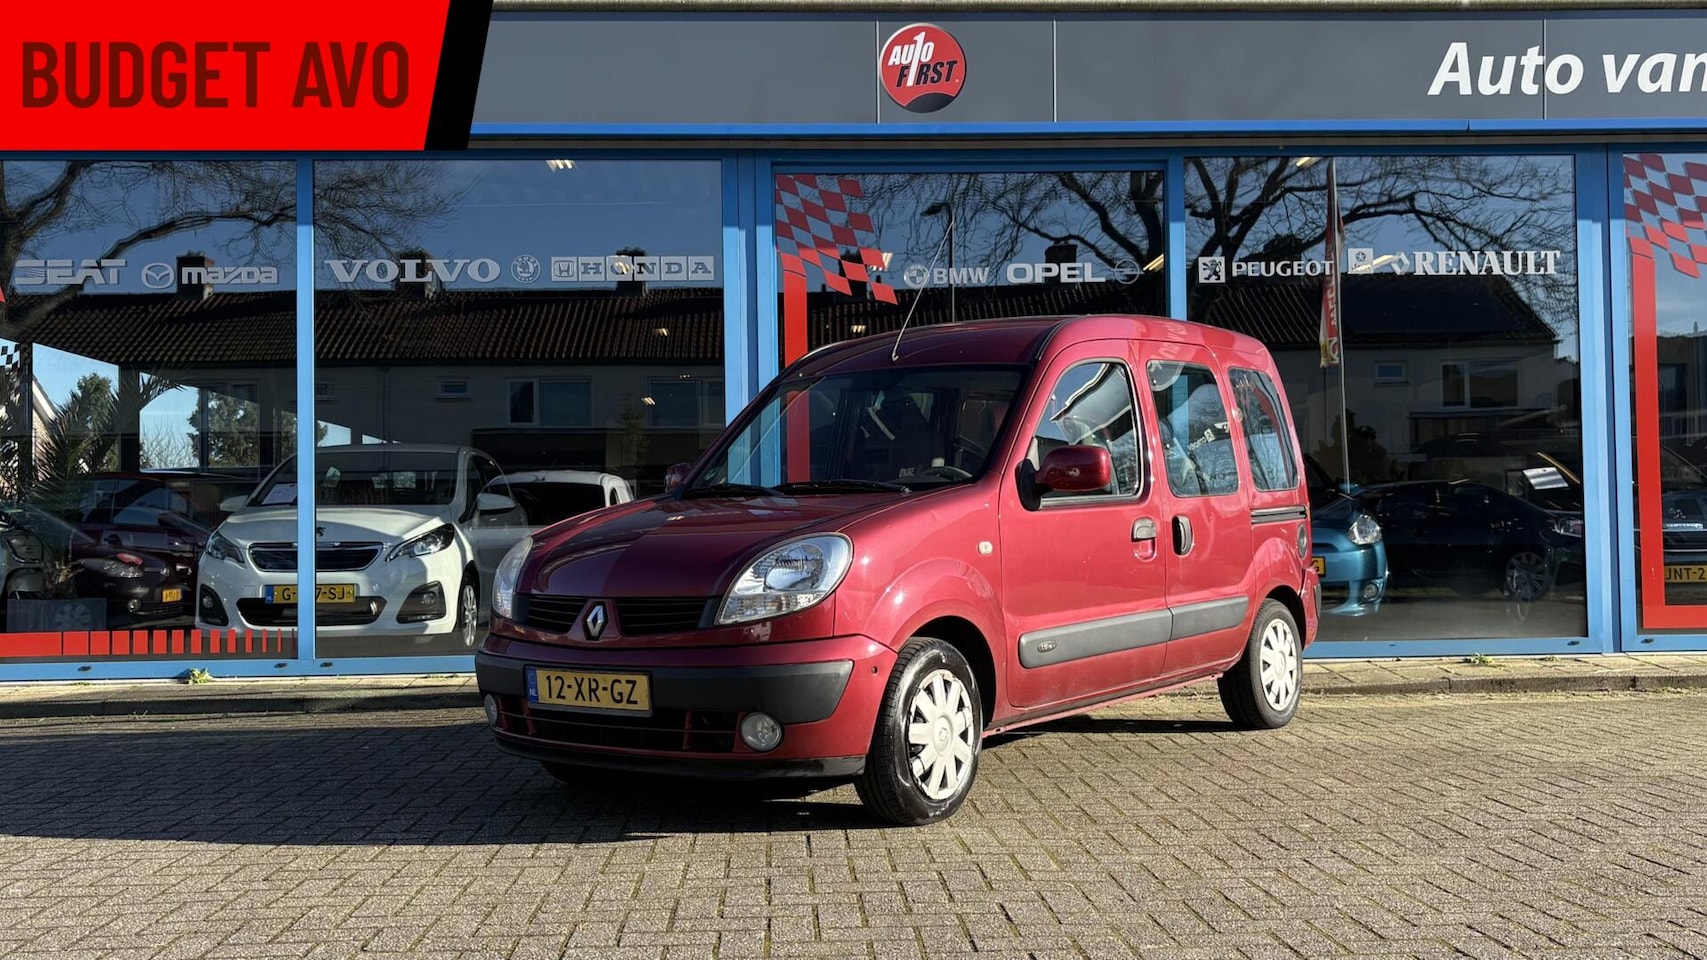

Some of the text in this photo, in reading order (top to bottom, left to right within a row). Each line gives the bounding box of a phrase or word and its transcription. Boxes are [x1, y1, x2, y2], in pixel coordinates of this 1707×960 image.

[1427, 42, 1707, 95] Auto van
[15, 259, 126, 285] SEAT
[324, 258, 501, 283] VOLVO
[1006, 263, 1106, 283] OPEL
[1232, 260, 1335, 277] PEUGEOT
[1413, 250, 1561, 275] RENAULT
[933, 267, 990, 285] BMW
[545, 674, 638, 705] 12-XR-GZ
